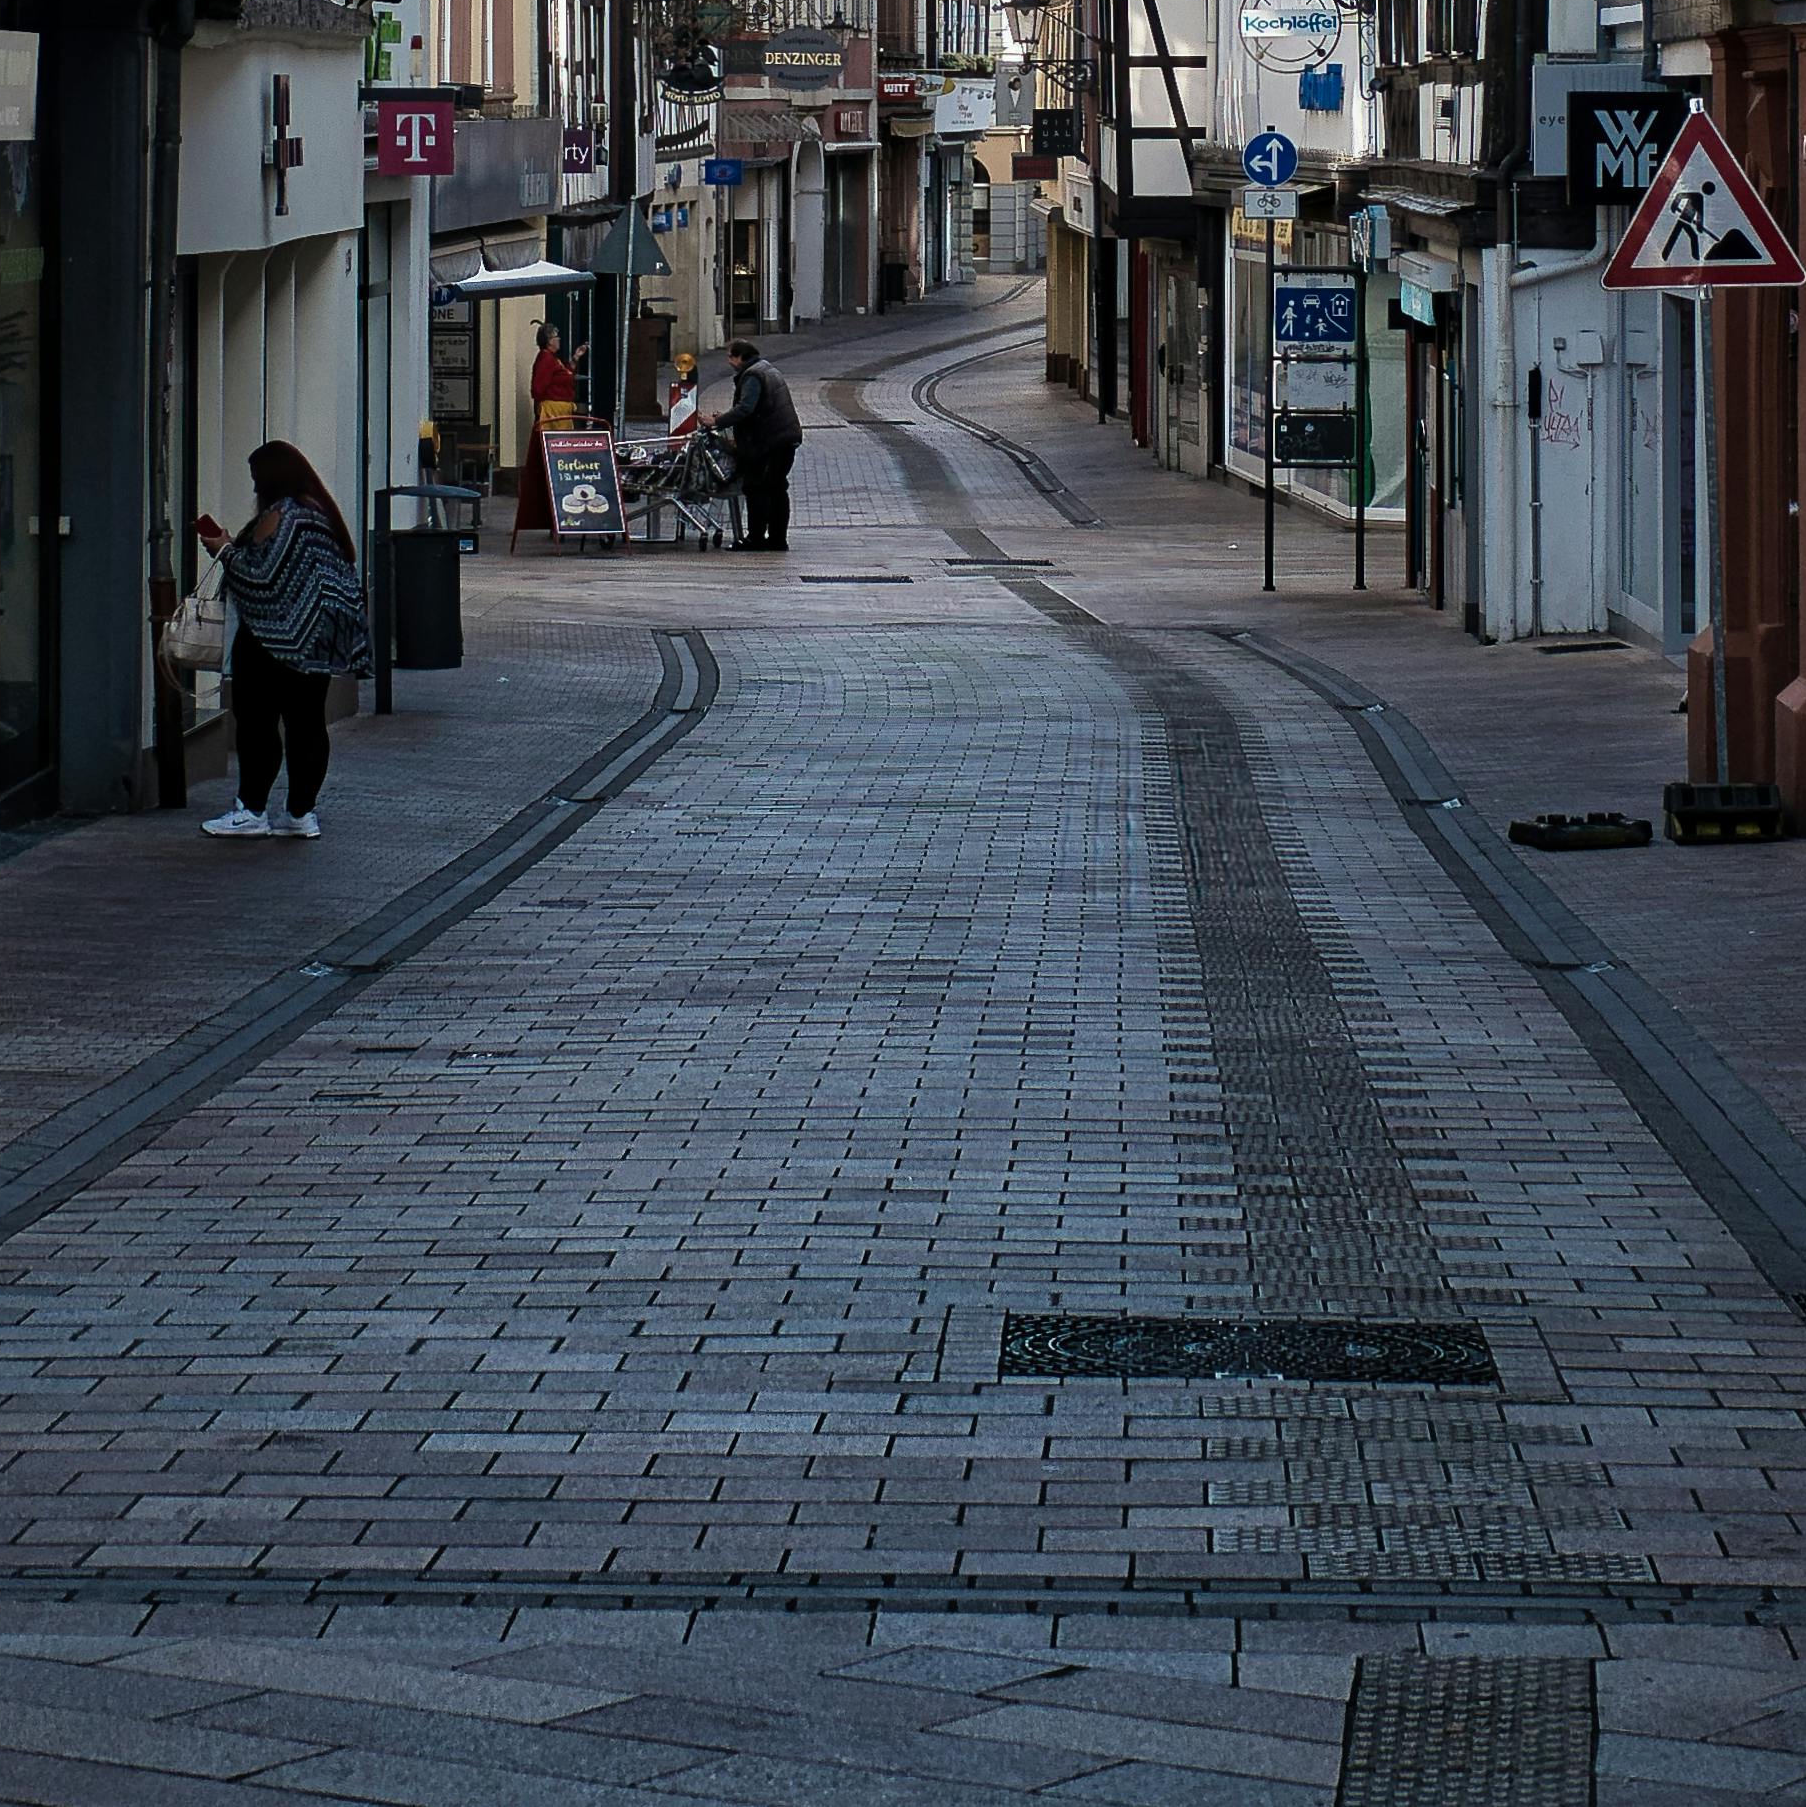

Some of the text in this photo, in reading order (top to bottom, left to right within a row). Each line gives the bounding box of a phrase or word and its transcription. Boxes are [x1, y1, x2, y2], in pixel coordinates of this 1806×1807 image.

[1243, 12, 1337, 33] Kochlöffel
[764, 52, 842, 67] DENZINGER
[883, 83, 910, 93] WITT
[564, 143, 589, 164] rty
[1593, 109, 1660, 188] WMF
